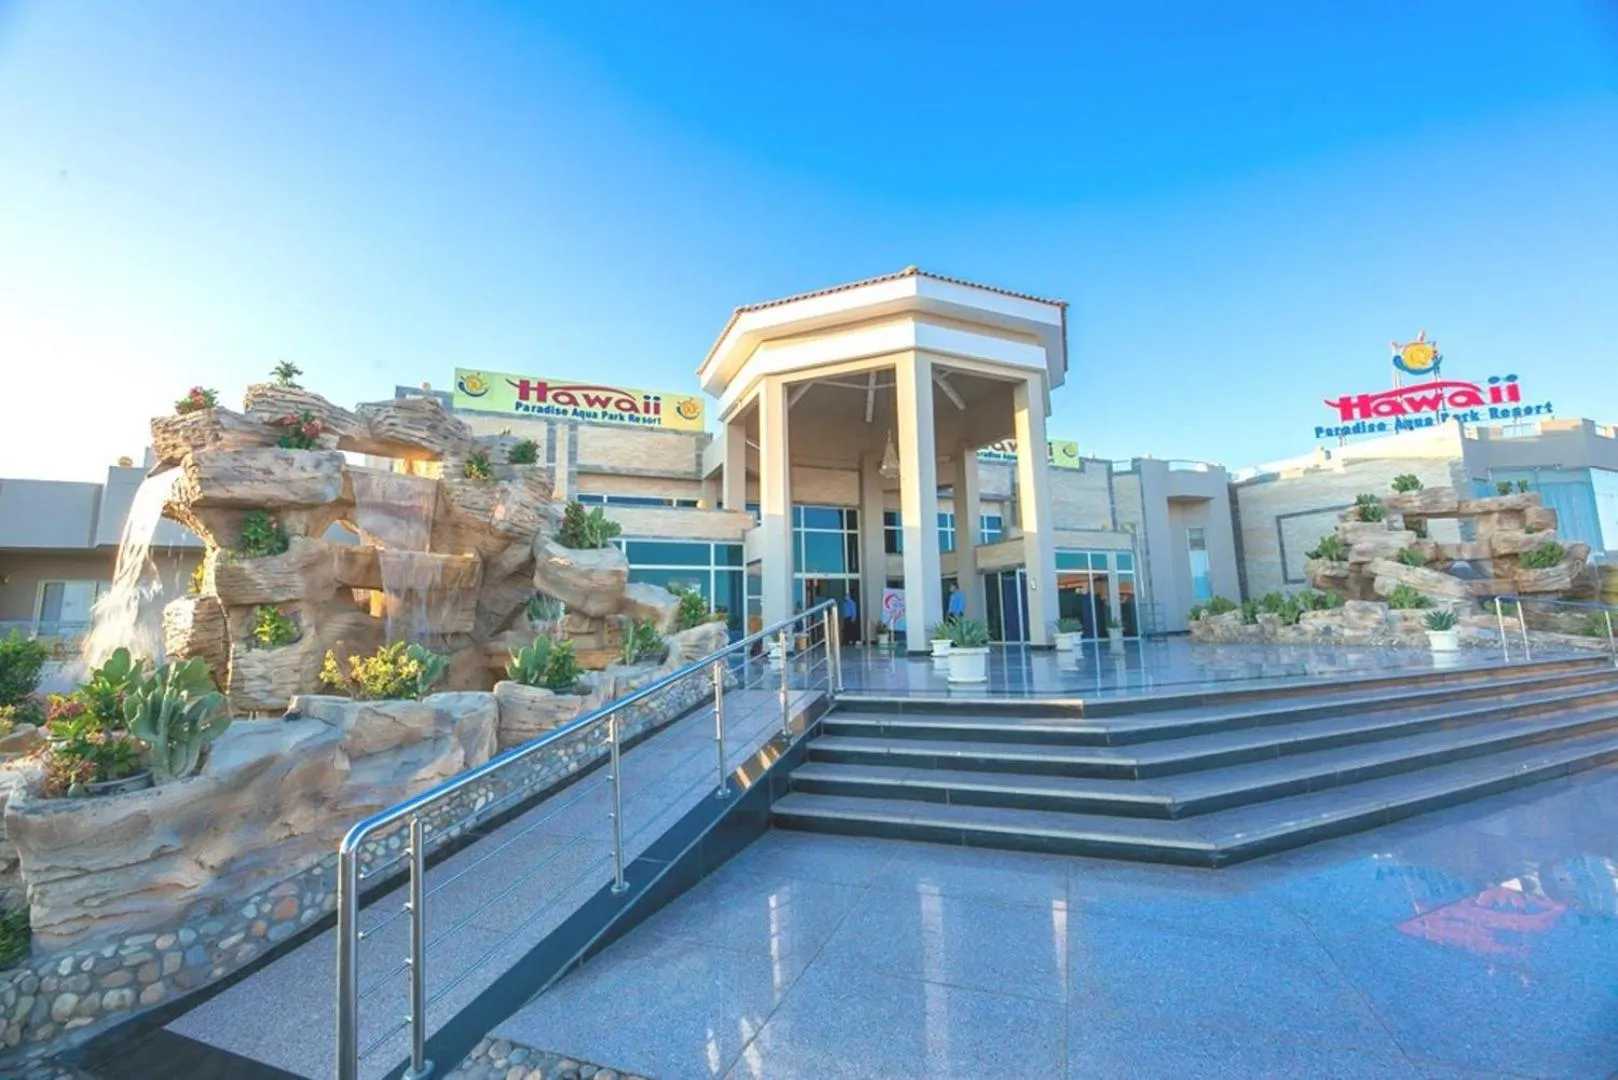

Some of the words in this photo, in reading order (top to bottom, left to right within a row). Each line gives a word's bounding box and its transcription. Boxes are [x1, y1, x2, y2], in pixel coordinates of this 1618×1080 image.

[505, 378, 661, 415] Hawaii
[515, 401, 568, 416] Paradise
[572, 408, 598, 420] Aqua
[601, 411, 625, 422] Park
[628, 413, 661, 425] Resort
[1323, 374, 1520, 421] Hawaii
[1315, 420, 1387, 438] Paradise
[1395, 416, 1433, 431] Aqua
[1489, 401, 1552, 419] Resort
